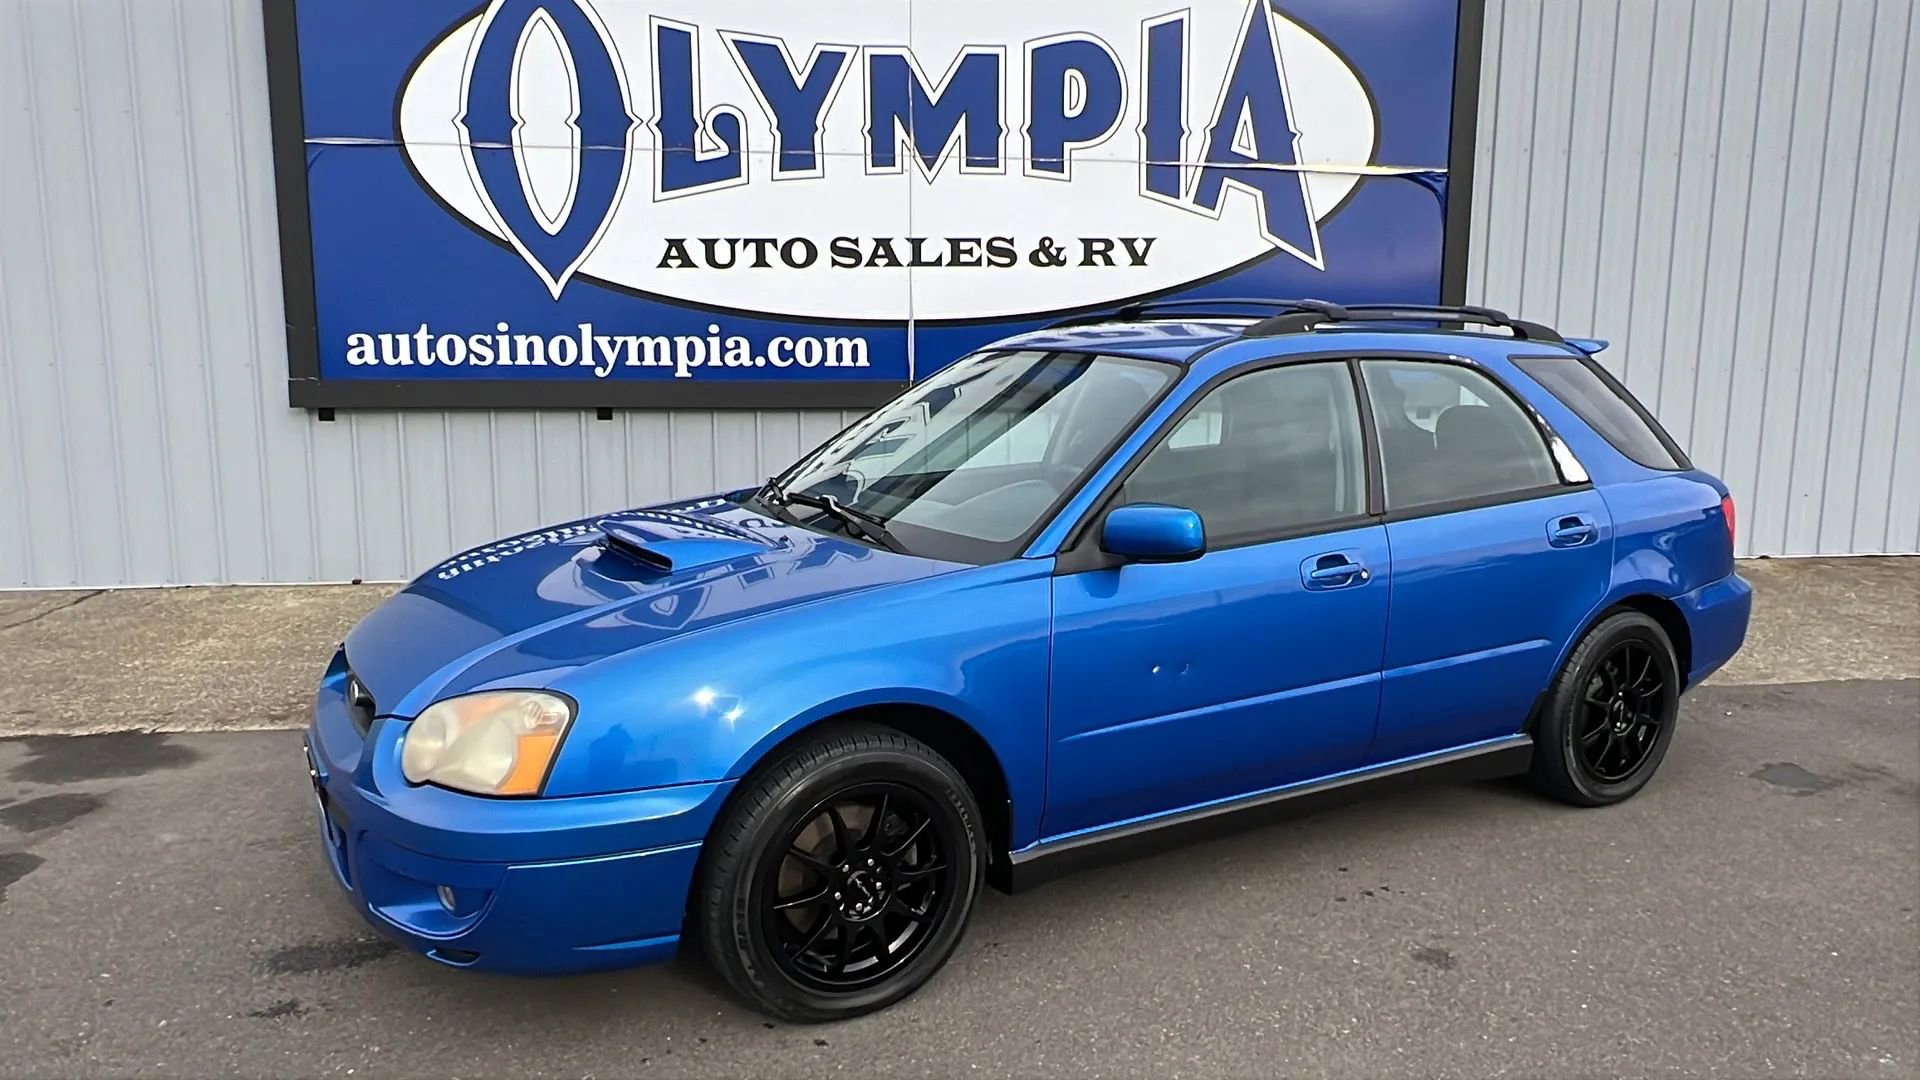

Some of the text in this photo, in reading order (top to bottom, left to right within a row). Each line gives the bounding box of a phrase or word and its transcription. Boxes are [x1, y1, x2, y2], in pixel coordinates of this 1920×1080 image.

[453, 0, 1325, 301] OLYMPIA
[656, 236, 1157, 269] AUTO SALES & RV
[346, 322, 870, 378] autosinolympia.com
